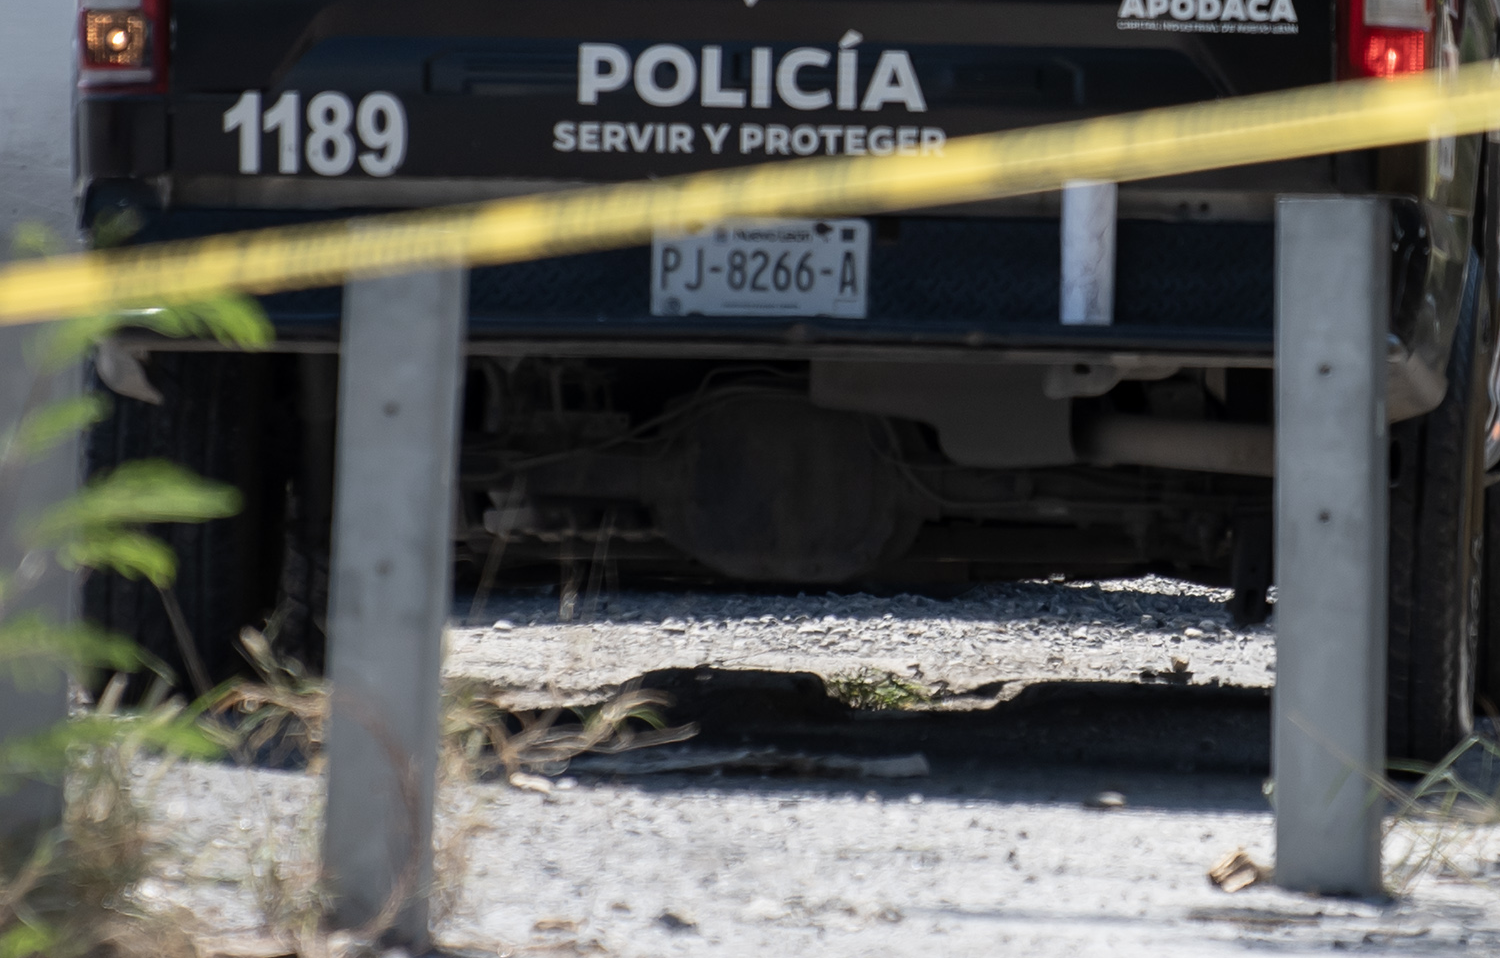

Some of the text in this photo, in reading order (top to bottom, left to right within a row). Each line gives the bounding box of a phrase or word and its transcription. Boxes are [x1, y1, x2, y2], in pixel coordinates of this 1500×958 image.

[577, 29, 928, 112] POLICÍA
[222, 90, 408, 177] 1189
[553, 121, 947, 158] SERVIR Y PROTEGER
[660, 246, 858, 294] PJ-8266-A
